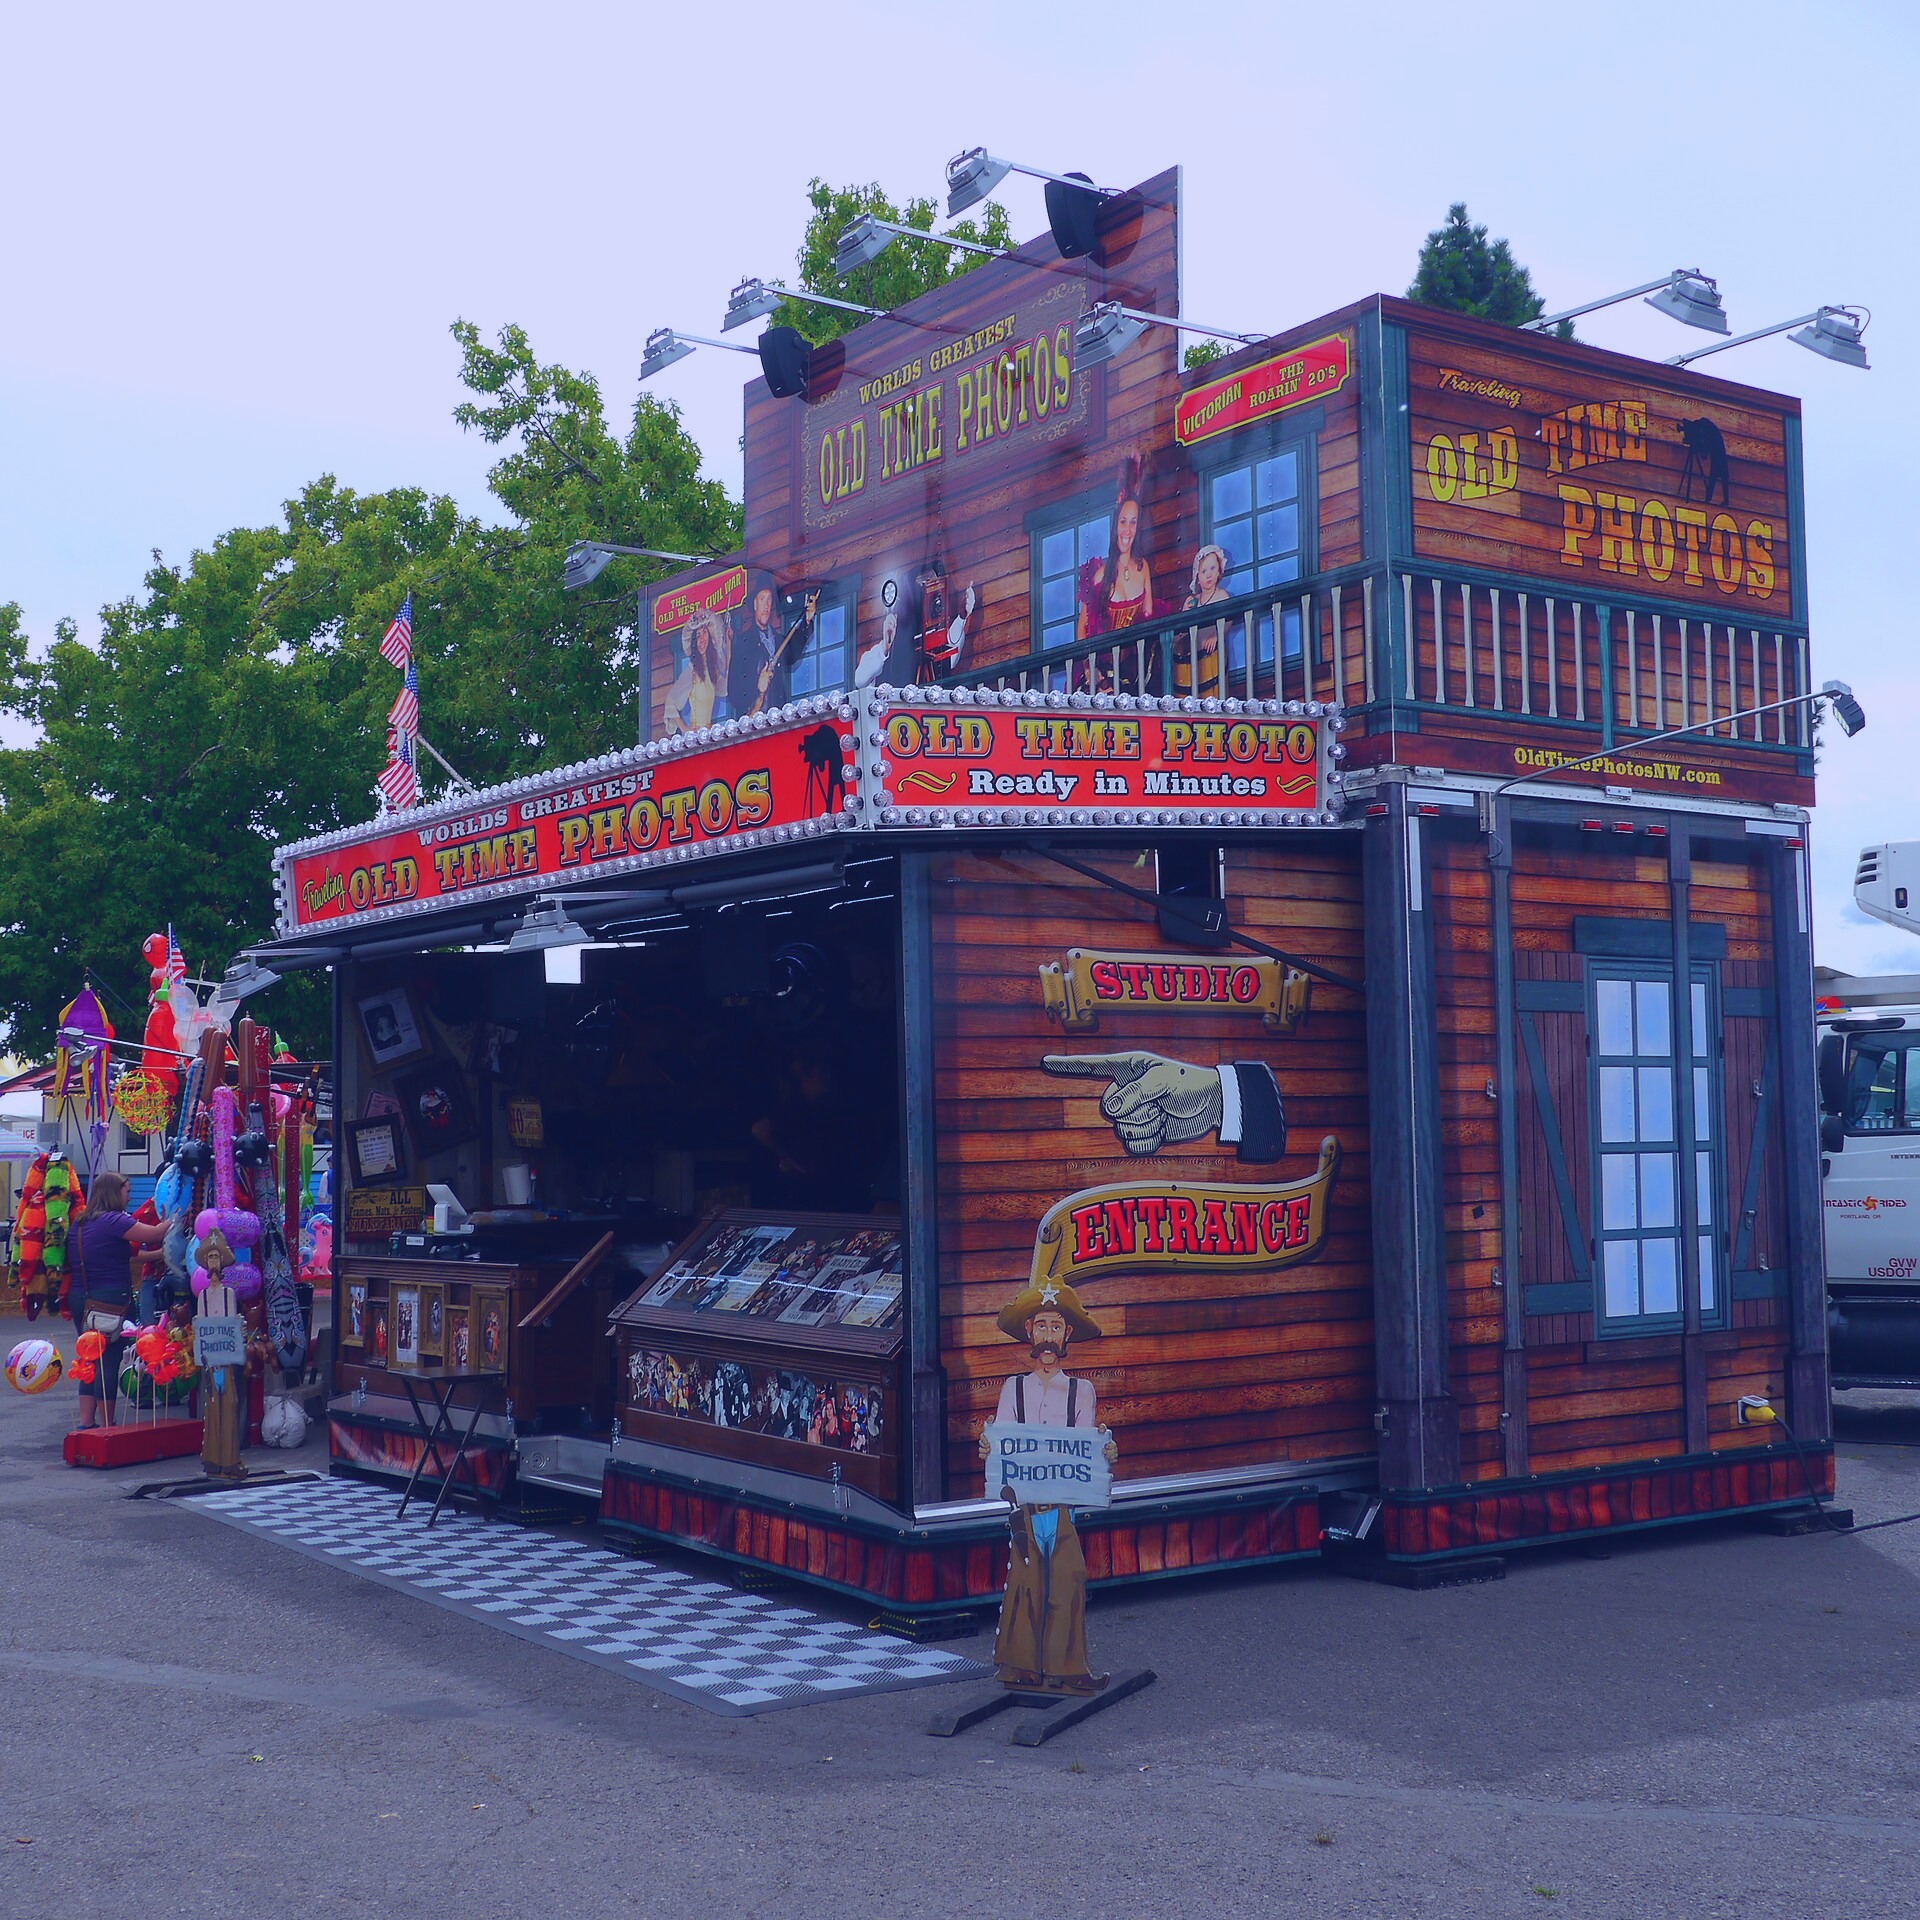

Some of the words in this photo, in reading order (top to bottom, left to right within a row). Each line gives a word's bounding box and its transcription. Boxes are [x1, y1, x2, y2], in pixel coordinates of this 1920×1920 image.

[859, 359, 923, 406] WORLDS
[929, 314, 1017, 372] GREATEST
[1279, 361, 1304, 381] THE
[1249, 378, 1302, 408] ROARIN'
[1308, 364, 1337, 387] 20'S
[1439, 367, 1522, 409] Traveling
[819, 417, 868, 507] OLD
[878, 381, 945, 483] TIME
[955, 322, 1073, 452] PHOTOS
[1183, 381, 1243, 436] VICTORIAN
[1541, 400, 1647, 478] TIME
[1426, 425, 1520, 502] OLD
[1557, 483, 1776, 600] PHOTOS
[704, 588, 724, 610] CIVIL
[724, 573, 742, 594] WAR
[658, 611, 674, 625] OLD
[677, 601, 701, 618] WEST
[670, 595, 687, 610] THE
[886, 714, 996, 761] OLD
[1016, 716, 1142, 762] TIME
[1162, 720, 1317, 765] PHOTO
[968, 769, 1079, 801] Ready
[1095, 770, 1128, 796] in
[1144, 770, 1267, 798] Minutes
[417, 808, 508, 848] WORLDS
[520, 769, 654, 822] GREATEST
[302, 865, 346, 920] Traveling
[348, 856, 420, 911] OLD
[434, 826, 539, 892] TIME
[558, 769, 773, 867] PHOTOS
[1090, 961, 1262, 1003] STUDIO
[22, 1129, 36, 1140] ICE
[390, 1191, 411, 1205] ALL
[1879, 1199, 1907, 1208] RIDES
[1071, 1193, 1312, 1265] ENTRANCE
[1868, 1267, 1913, 1278] USDOT
[1889, 1257, 1917, 1268] GVW
[199, 1326, 215, 1338] OLD
[216, 1326, 236, 1339] TIME
[200, 1339, 236, 1355] PHOTOS
[1000, 1437, 1039, 1457] OLD
[1045, 1438, 1092, 1459] TIME
